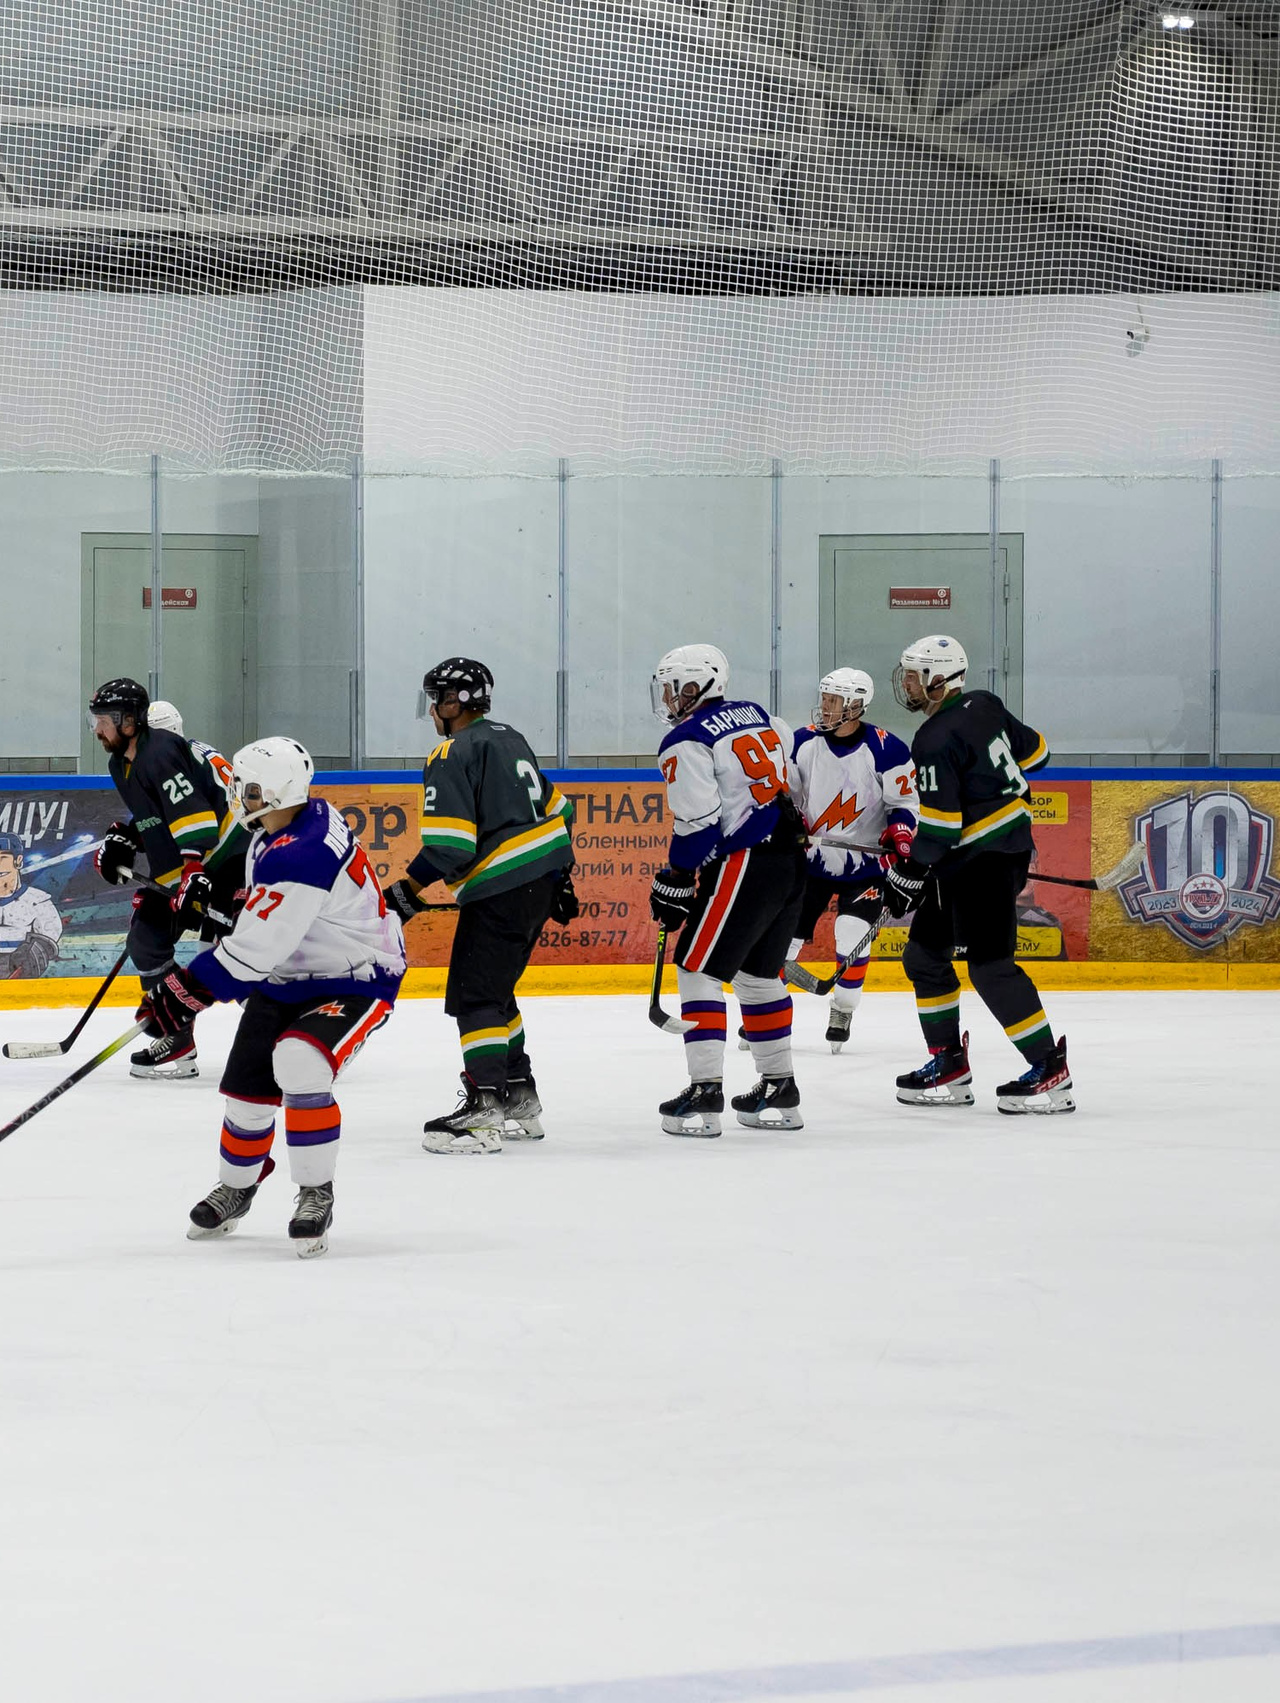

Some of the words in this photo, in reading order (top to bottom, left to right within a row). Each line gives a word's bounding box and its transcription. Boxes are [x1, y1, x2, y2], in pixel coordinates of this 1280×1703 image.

[700, 705, 765, 737] БАРАШКО
[988, 730, 1029, 797] 3
[162, 772, 194, 806] 25
[918, 764, 939, 792] 31
[566, 793, 664, 824] ТНАЯ
[1031, 797, 1053, 806] БОР
[1033, 810, 1056, 819] ССЫ
[570, 831, 668, 850] бленным
[1151, 790, 1251, 893] 10
[570, 859, 615, 881] огий
[887, 868, 925, 890] ARRIOR
[345, 843, 388, 921] 7
[579, 901, 629, 918] 70-70
[1231, 895, 1261, 911] 2024
[1016, 942, 1040, 952] ЕМУ
